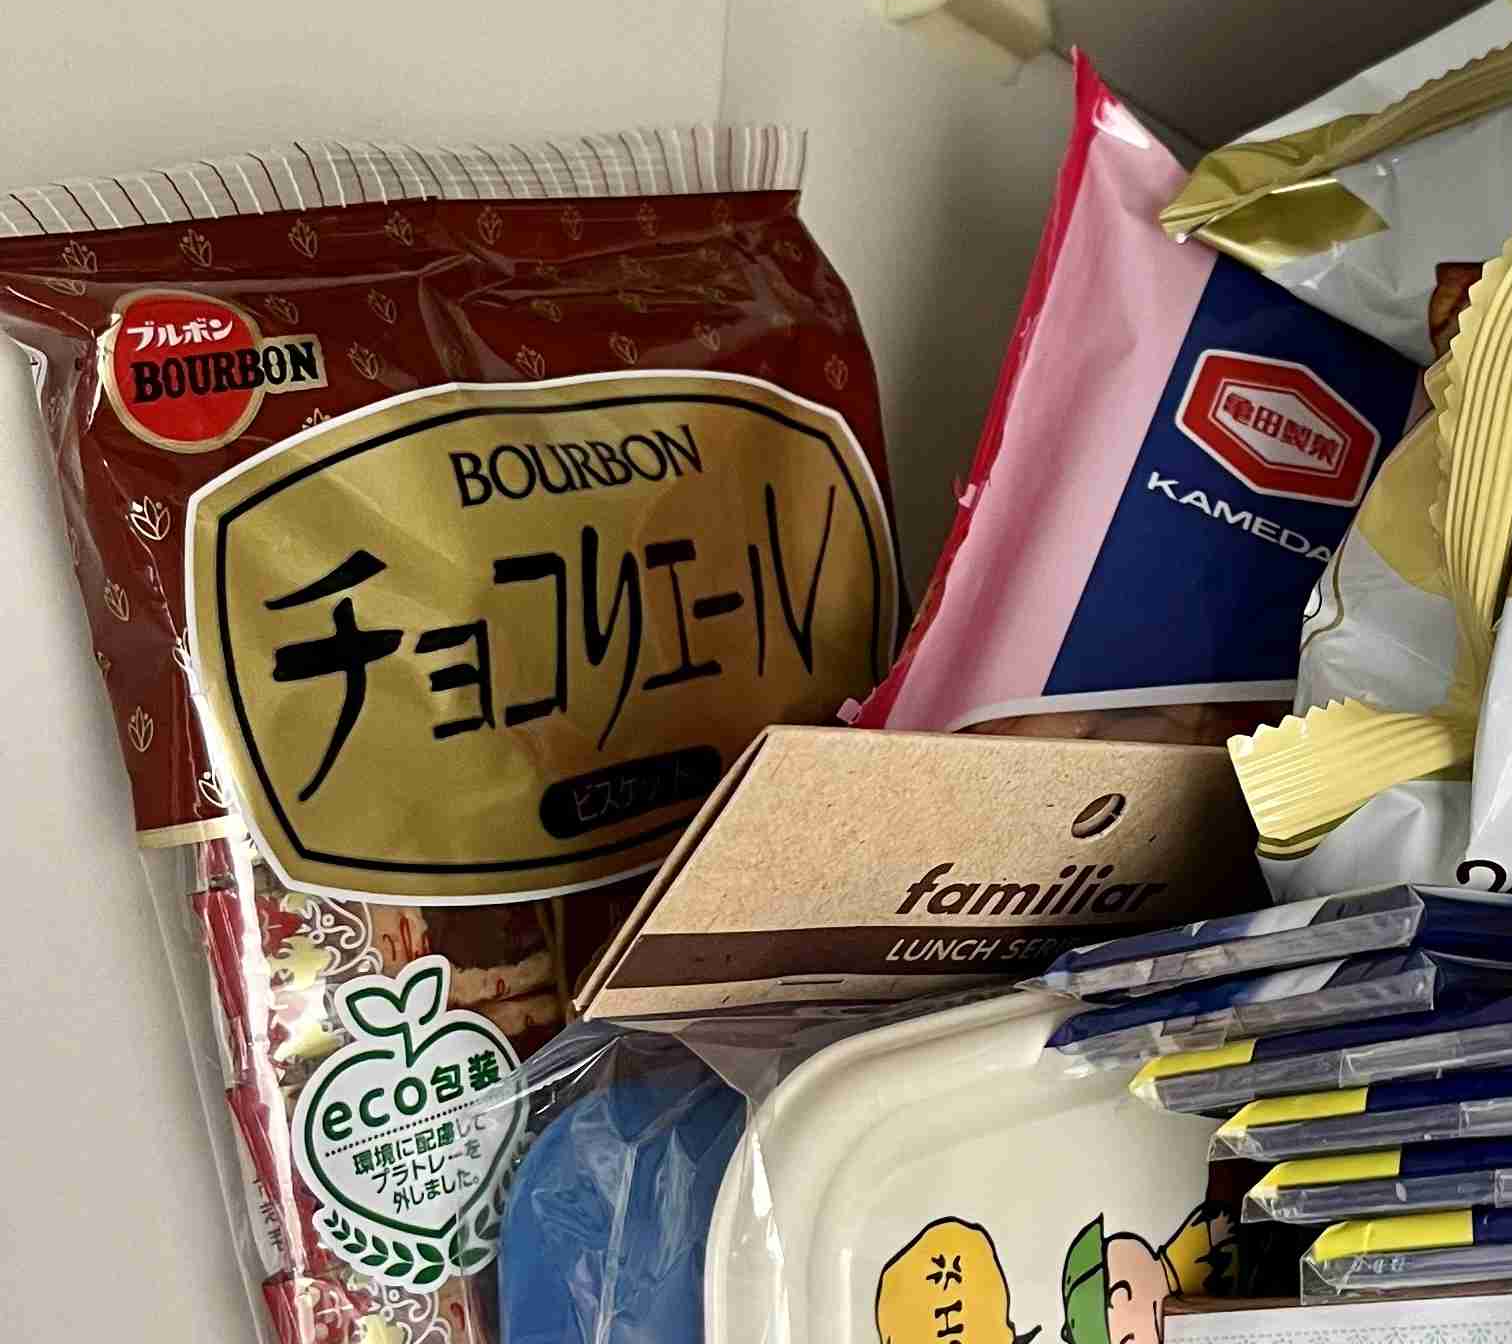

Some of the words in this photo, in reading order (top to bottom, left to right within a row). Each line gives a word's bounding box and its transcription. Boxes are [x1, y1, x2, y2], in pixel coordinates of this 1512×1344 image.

[127, 315, 233, 352] ブルボン
[130, 342, 321, 405] BOURBON
[1221, 391, 1340, 469] 亀田製菓
[449, 425, 702, 509] BOURBON
[1147, 470, 1334, 563] KAMEDA
[265, 483, 836, 803] チョコリエール
[895, 862, 1167, 916] familiar
[885, 938, 1002, 963] LUNCH
[321, 1049, 503, 1144] eco包装
[351, 1117, 486, 1177] 環境に配慮して
[392, 1168, 480, 1215] 外しました。
